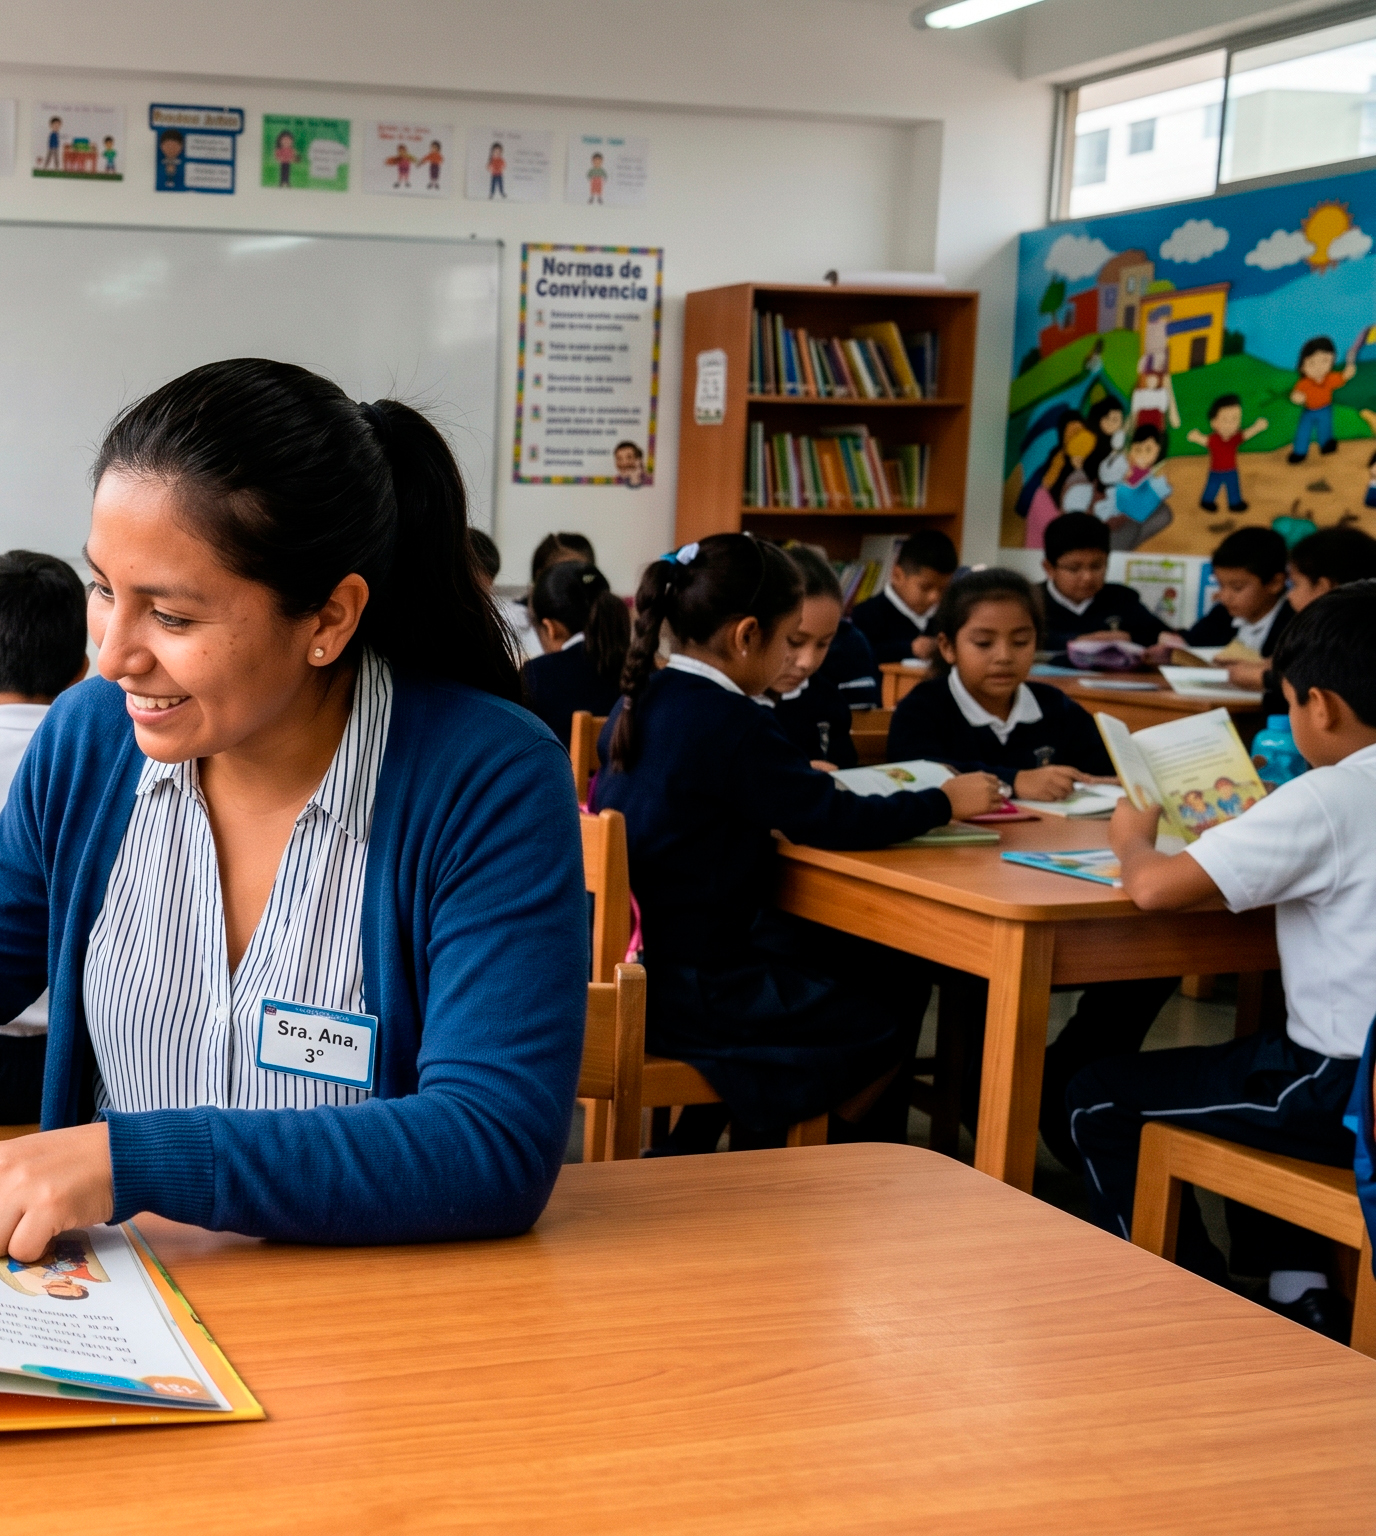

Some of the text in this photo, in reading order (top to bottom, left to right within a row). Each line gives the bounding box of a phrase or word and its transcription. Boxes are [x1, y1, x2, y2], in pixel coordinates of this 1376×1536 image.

[542, 257, 642, 279] Normas de
[535, 279, 648, 301] Convivencia
[277, 1020, 358, 1051] Sra. Ana,
